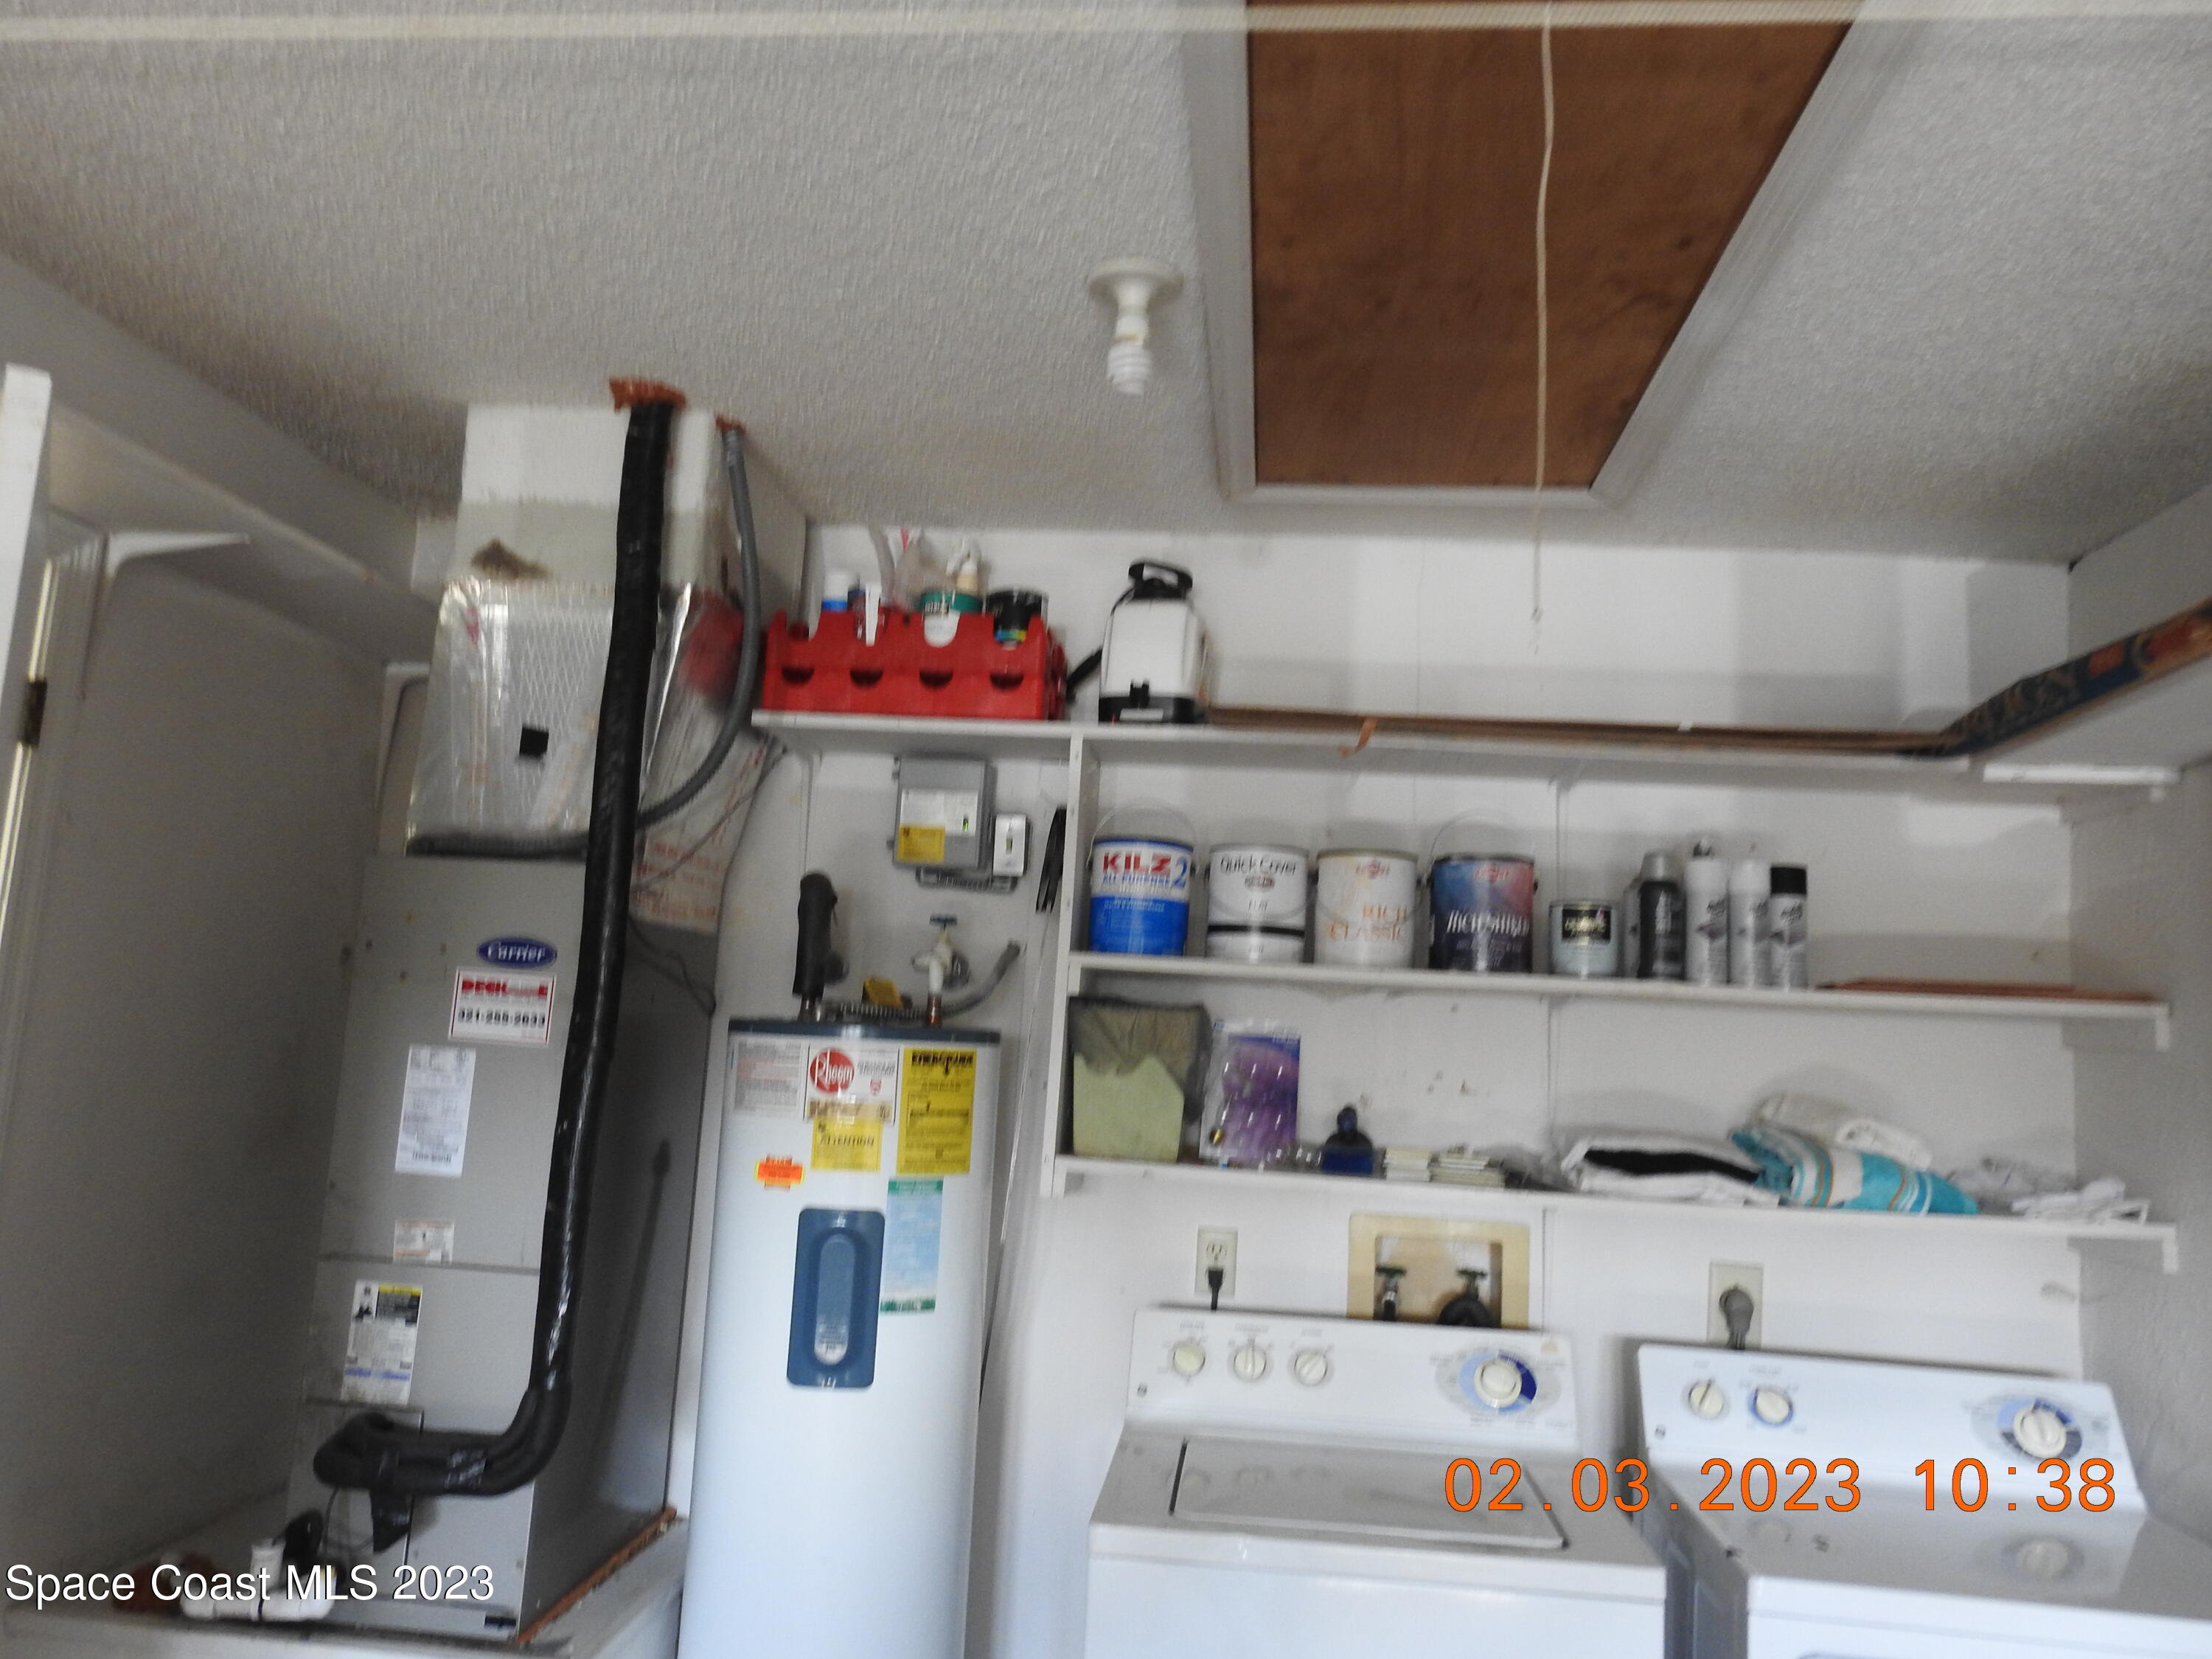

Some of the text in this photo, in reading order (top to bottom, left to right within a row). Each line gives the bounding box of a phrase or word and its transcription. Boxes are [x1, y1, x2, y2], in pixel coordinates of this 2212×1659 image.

[1102, 852, 1188, 889] KILZ 2
[813, 1048, 854, 1088] Rheem
